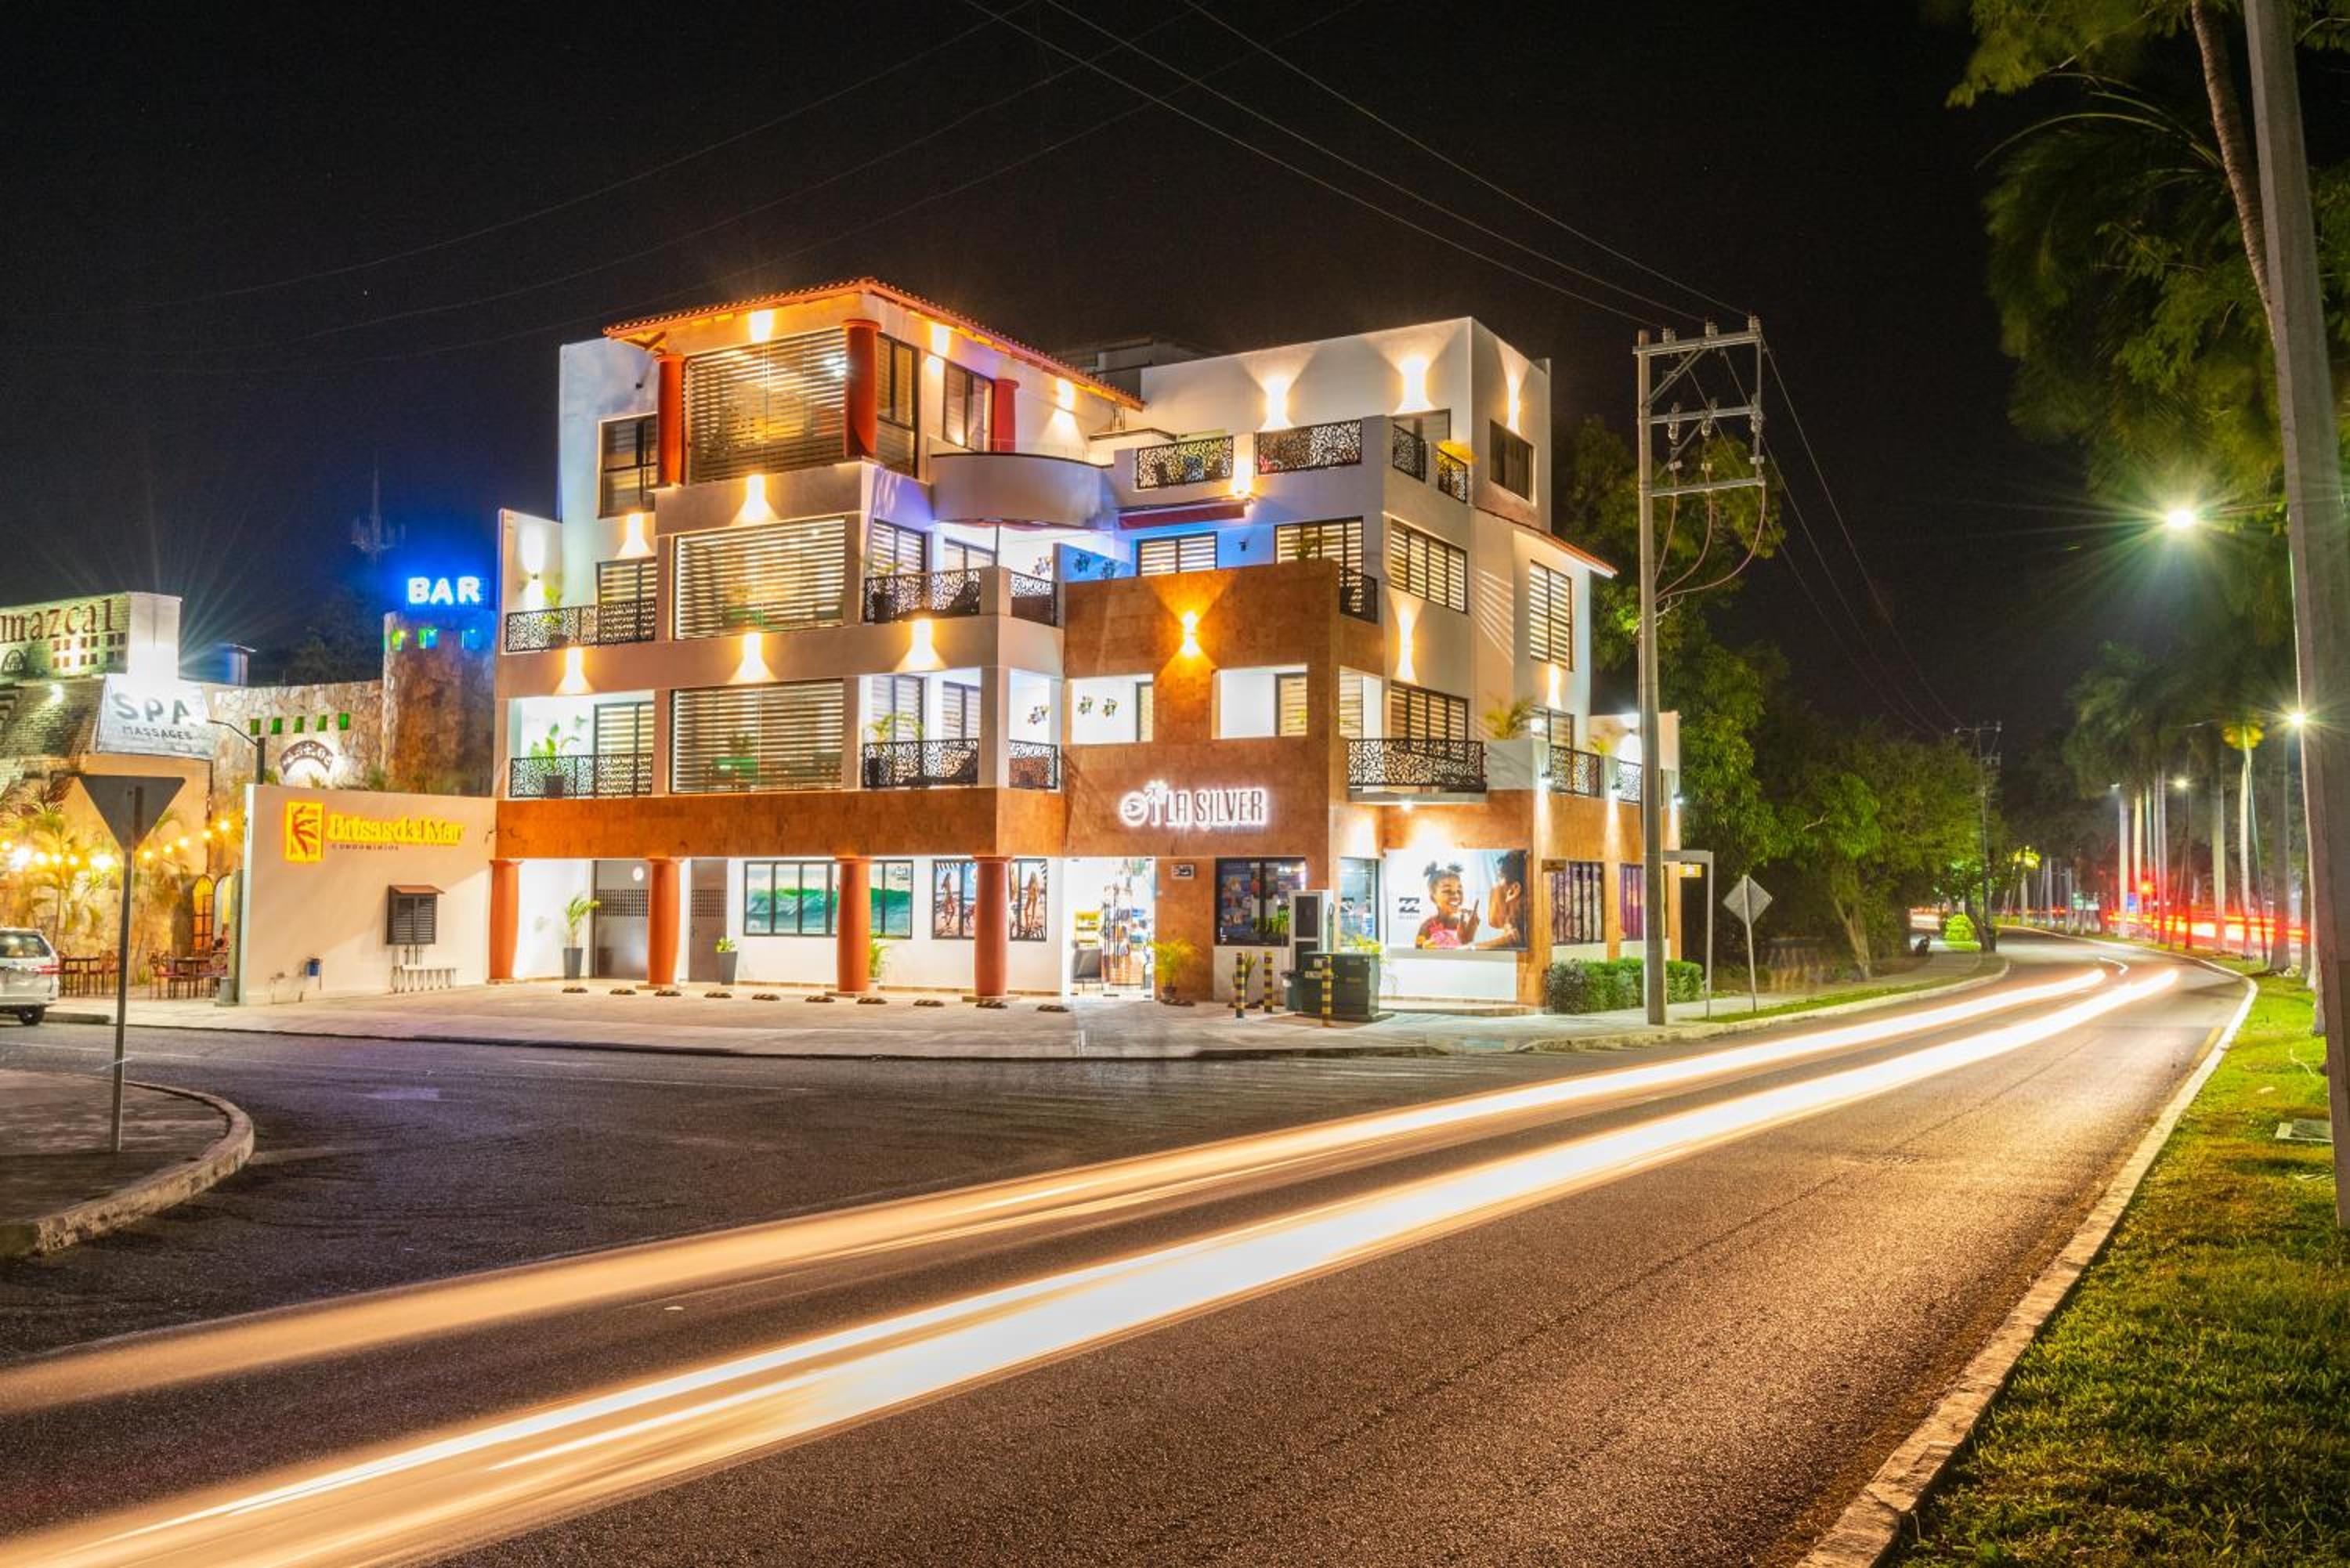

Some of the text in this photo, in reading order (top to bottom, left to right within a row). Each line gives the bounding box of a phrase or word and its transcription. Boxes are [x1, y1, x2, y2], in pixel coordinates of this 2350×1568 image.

[408, 576, 480, 604] BAR
[110, 691, 197, 727] SPA
[122, 725, 193, 740] MASSAGES
[1195, 789, 1263, 824] SILVER
[427, 818, 464, 844] Mar
